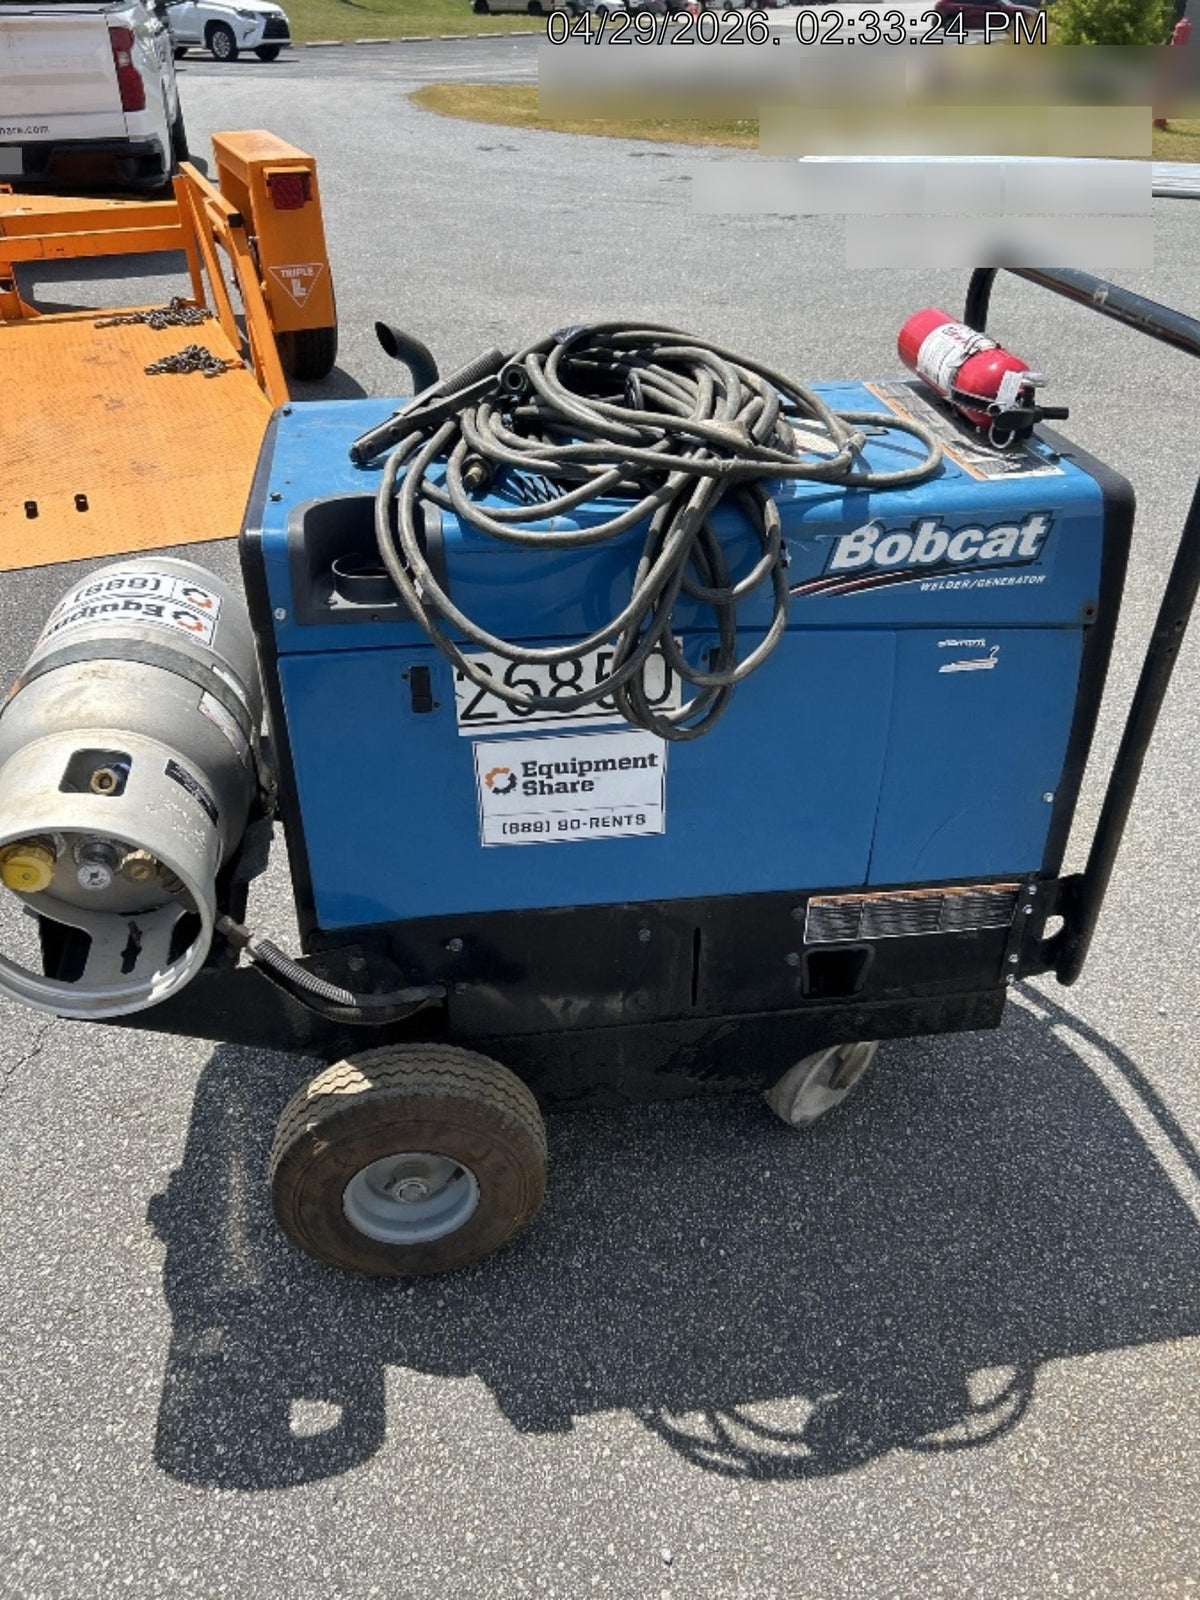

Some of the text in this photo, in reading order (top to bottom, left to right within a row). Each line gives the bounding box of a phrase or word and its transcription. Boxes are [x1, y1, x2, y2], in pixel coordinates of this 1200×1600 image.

[281, 266, 314, 278] TRIPLE
[291, 279, 307, 297] L
[829, 513, 1048, 570] Bobcat
[920, 574, 1046, 591] WELDER/GENERATOR
[521, 753, 659, 779] Equipment
[521, 779, 595, 796] Share
